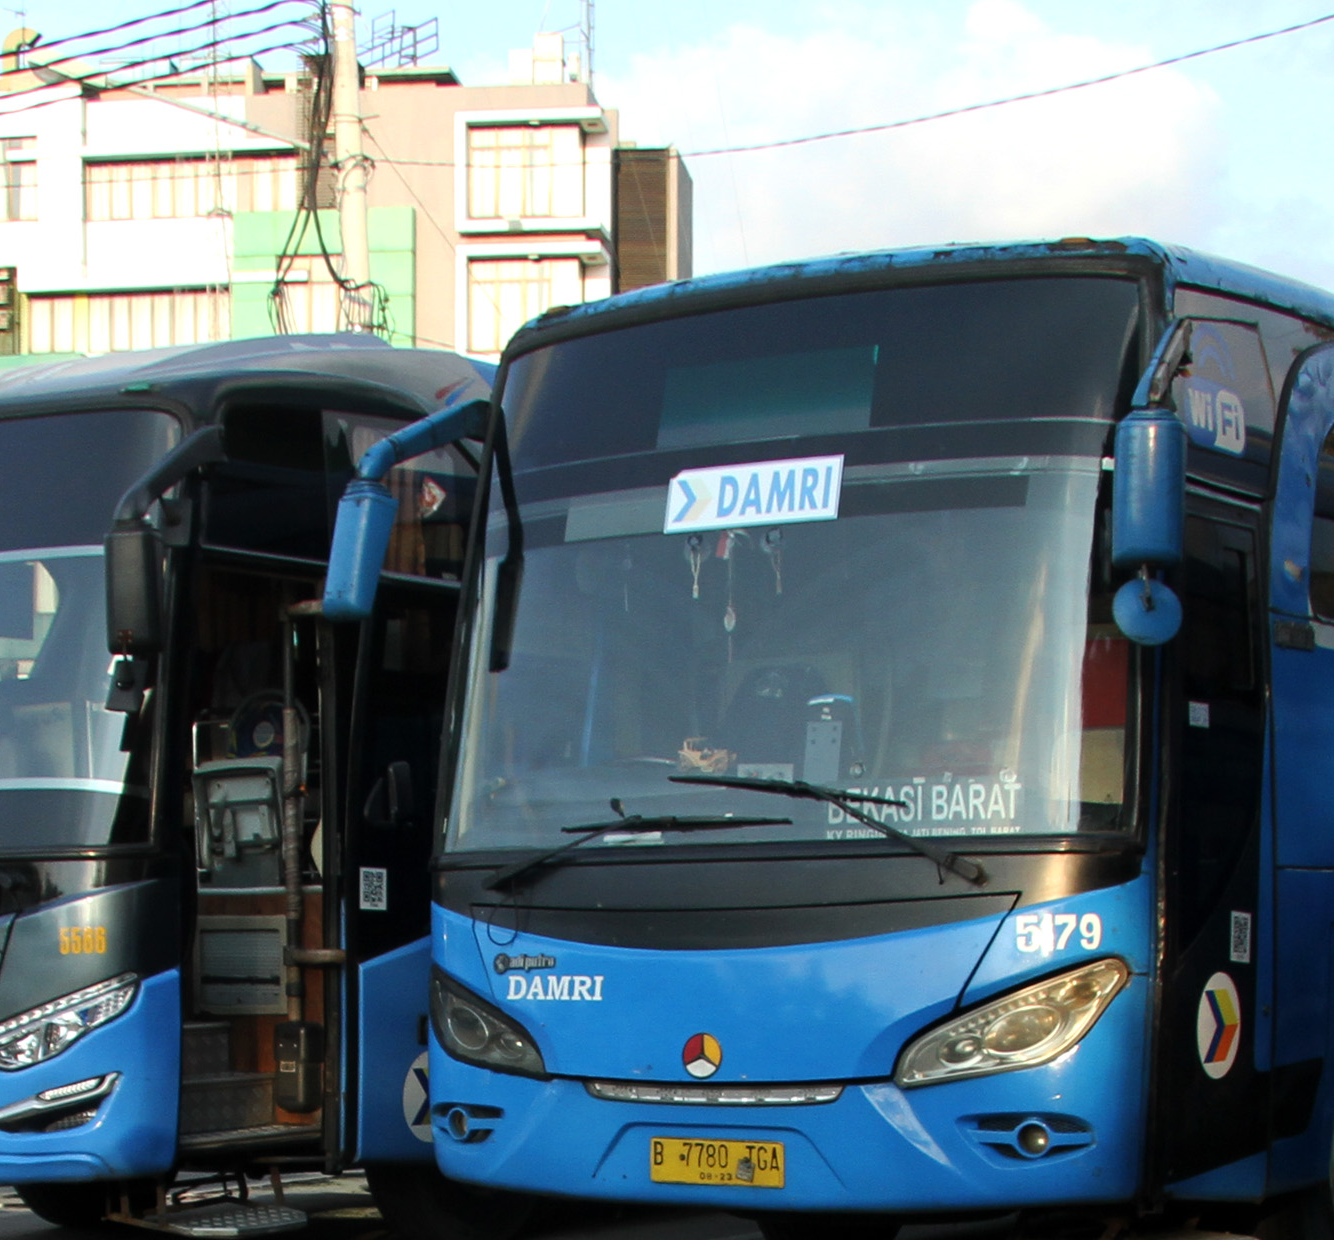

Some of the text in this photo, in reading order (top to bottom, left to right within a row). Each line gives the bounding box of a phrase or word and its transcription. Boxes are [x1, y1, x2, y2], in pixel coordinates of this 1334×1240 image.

[716, 465, 833, 518] DAMRI
[932, 783, 1021, 821] BARAT
[1016, 912, 1102, 953] 5179
[507, 975, 605, 1001] DAMRI
[654, 1141, 780, 1172] B 7780 TGA
